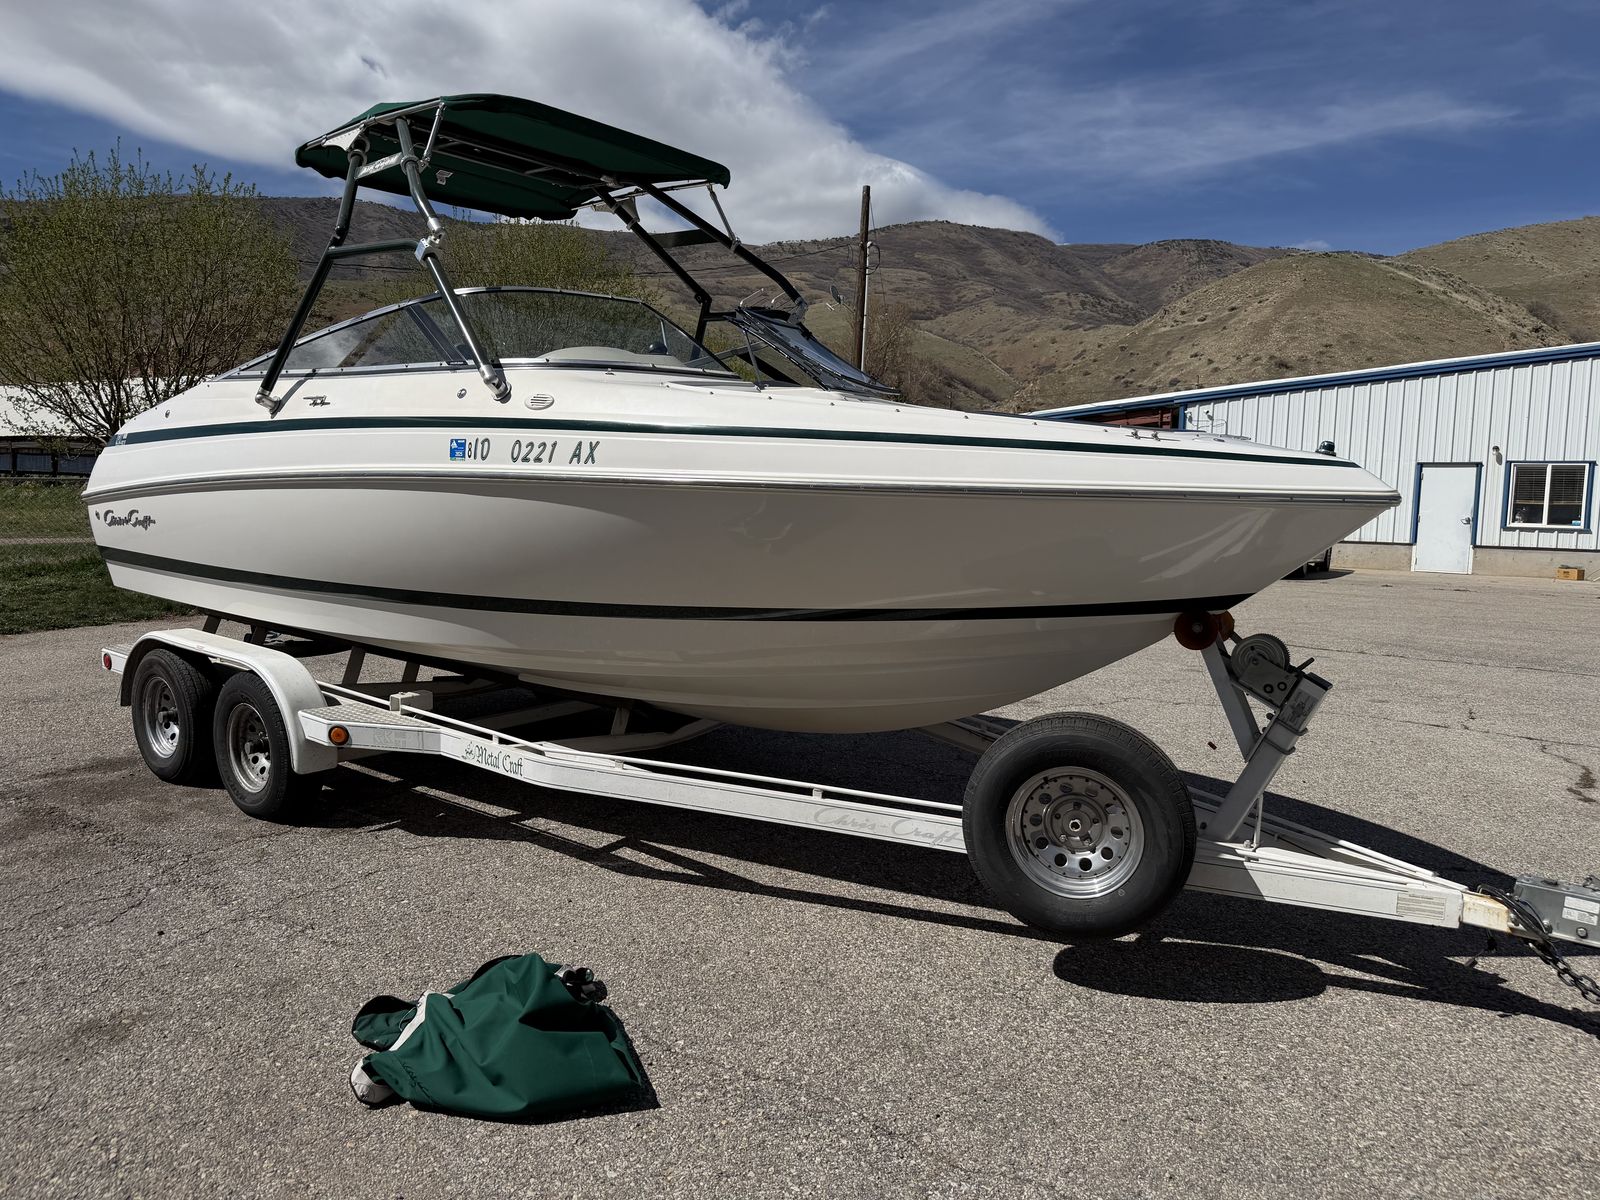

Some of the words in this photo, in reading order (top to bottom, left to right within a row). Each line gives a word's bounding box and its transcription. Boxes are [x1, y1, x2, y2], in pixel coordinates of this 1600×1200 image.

[510, 439, 558, 463] 0221
[568, 440, 601, 465] AX
[475, 744, 502, 770] Metal
[502, 754, 523, 777] Craft
